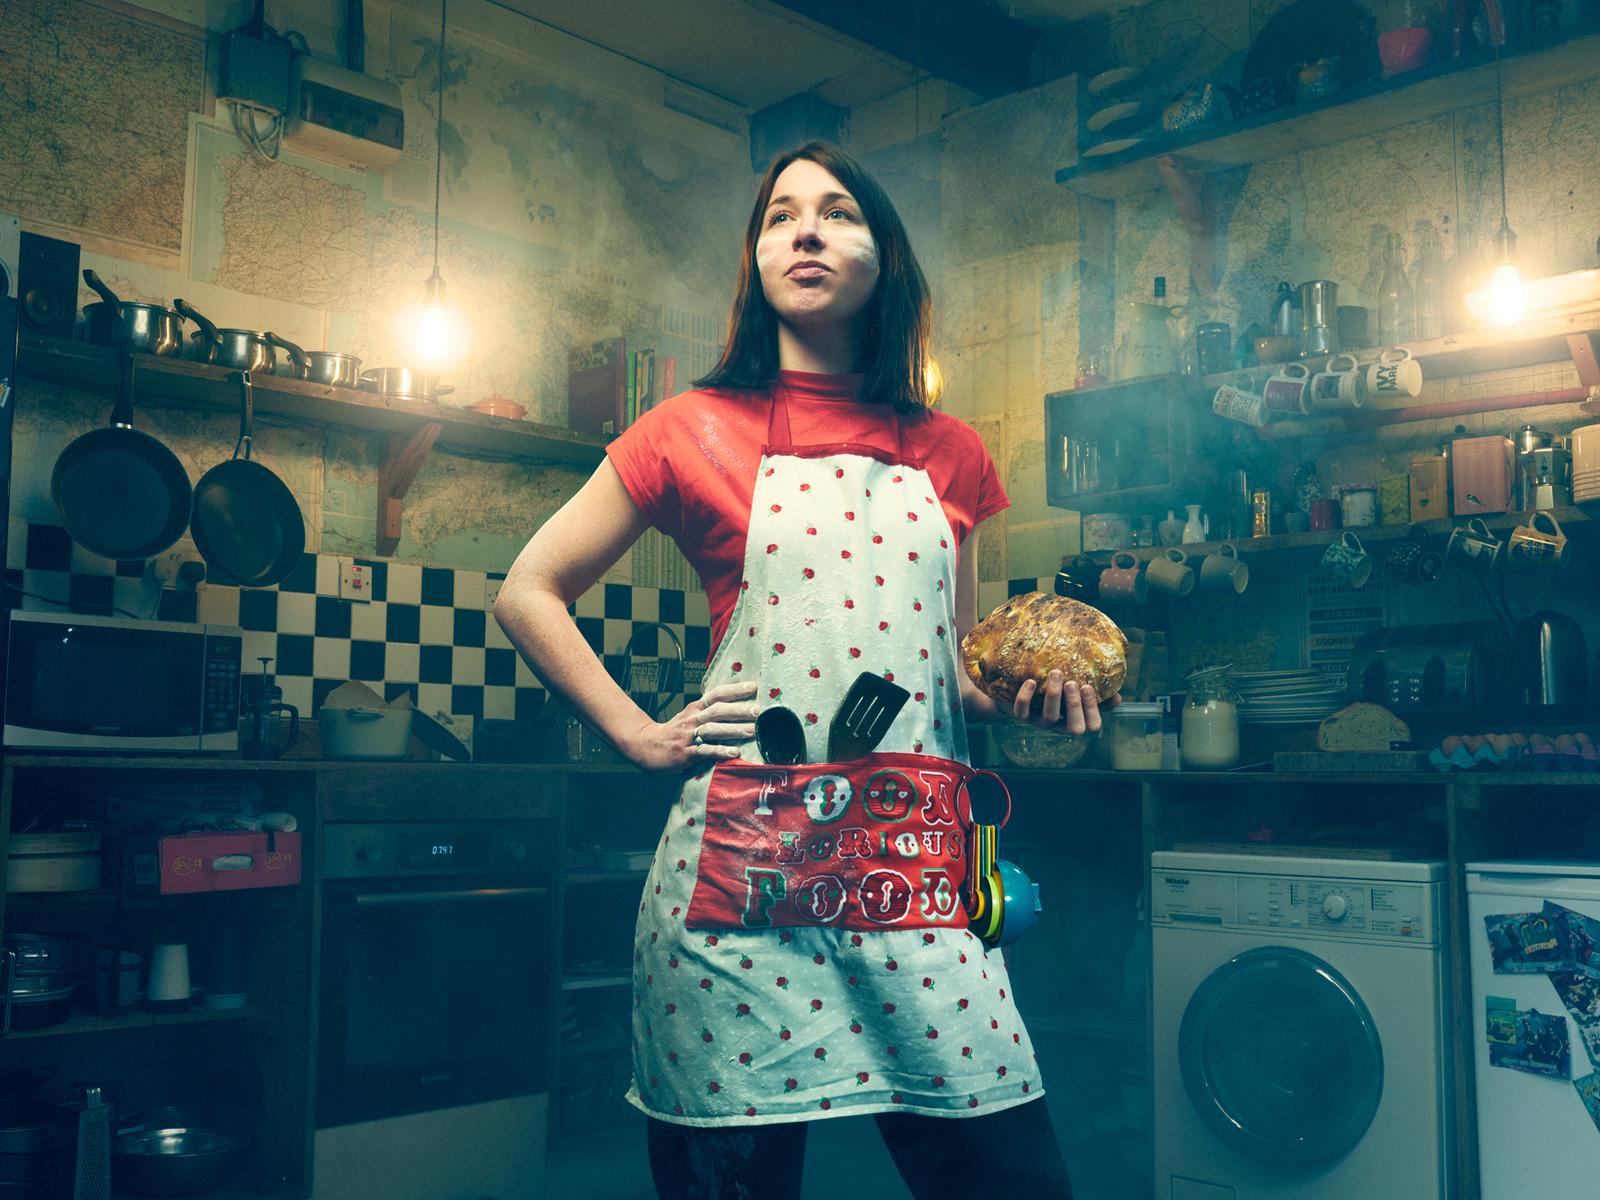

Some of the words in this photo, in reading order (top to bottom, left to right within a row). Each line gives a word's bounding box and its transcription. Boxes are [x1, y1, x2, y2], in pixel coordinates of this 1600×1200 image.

[1377, 365, 1390, 391] IVY
[1389, 364, 1399, 391] PARK
[754, 769, 954, 825] FOOD
[775, 828, 963, 865] LORIOUS
[742, 866, 960, 928] FOOD
